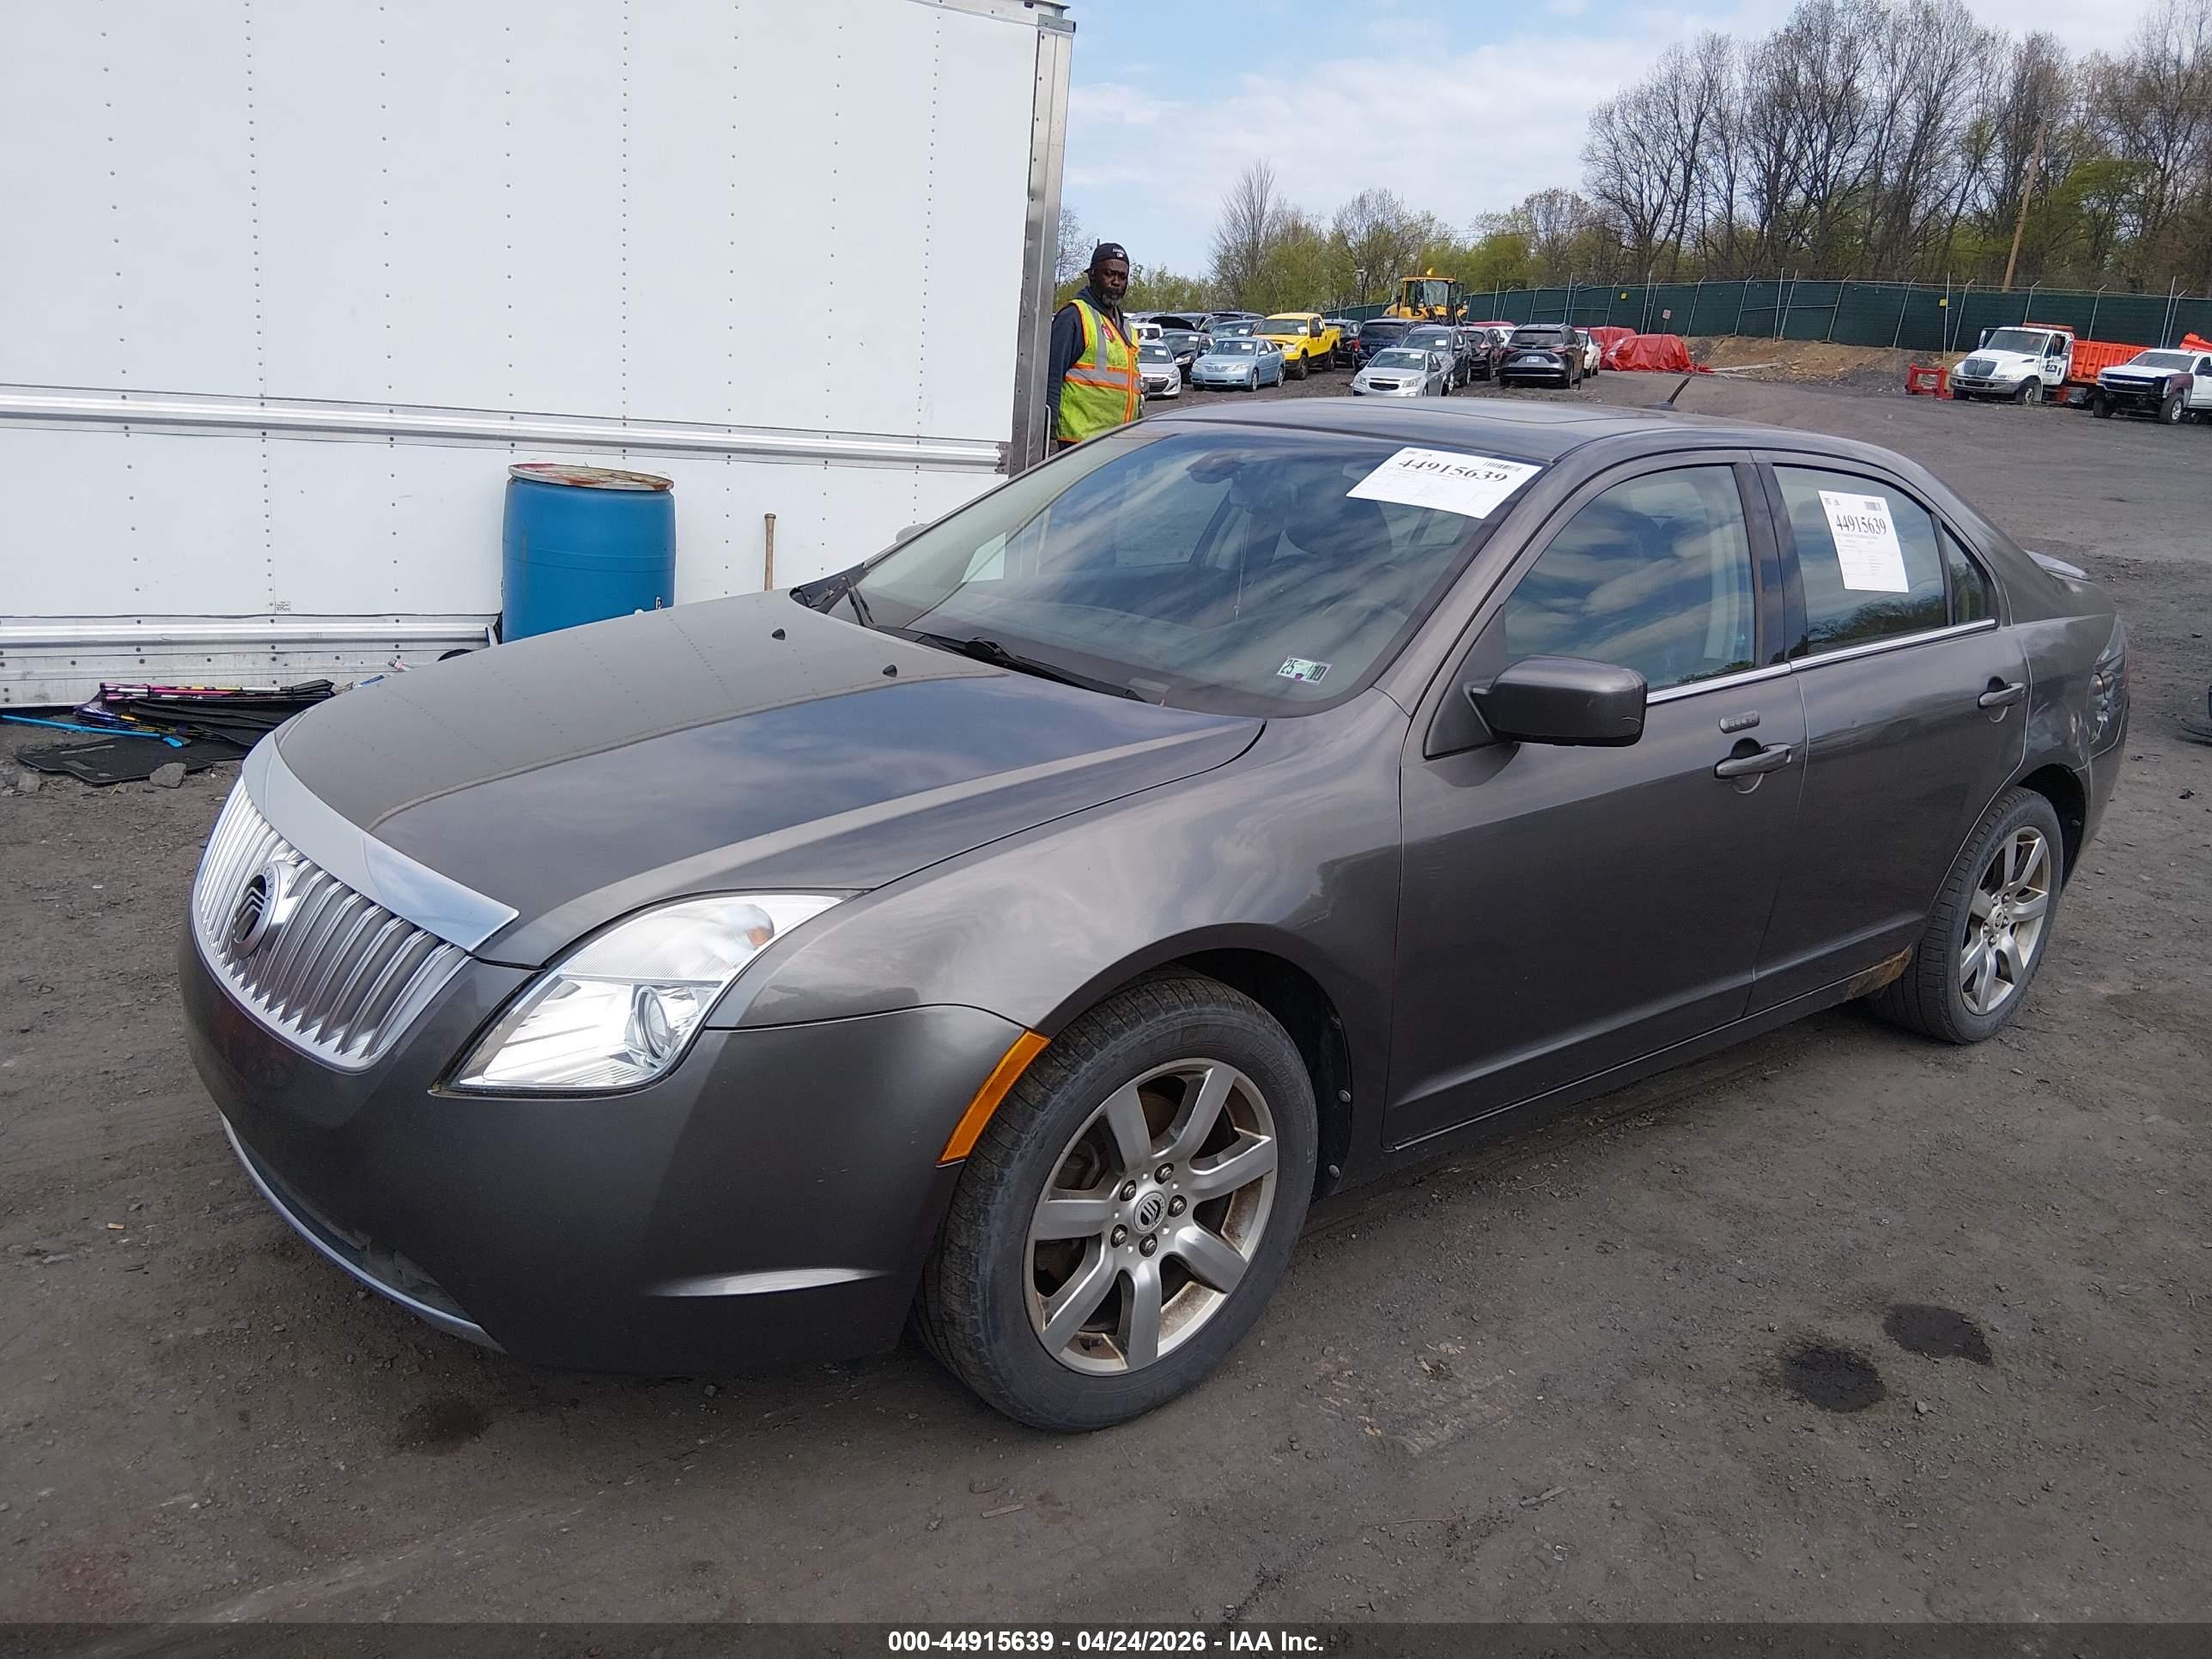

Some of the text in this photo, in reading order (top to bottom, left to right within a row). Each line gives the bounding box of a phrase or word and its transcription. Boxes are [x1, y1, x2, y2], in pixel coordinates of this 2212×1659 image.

[1399, 458, 1509, 483] 44915639
[1836, 514, 1887, 535] 44915639
[1280, 659, 1299, 674] 25
